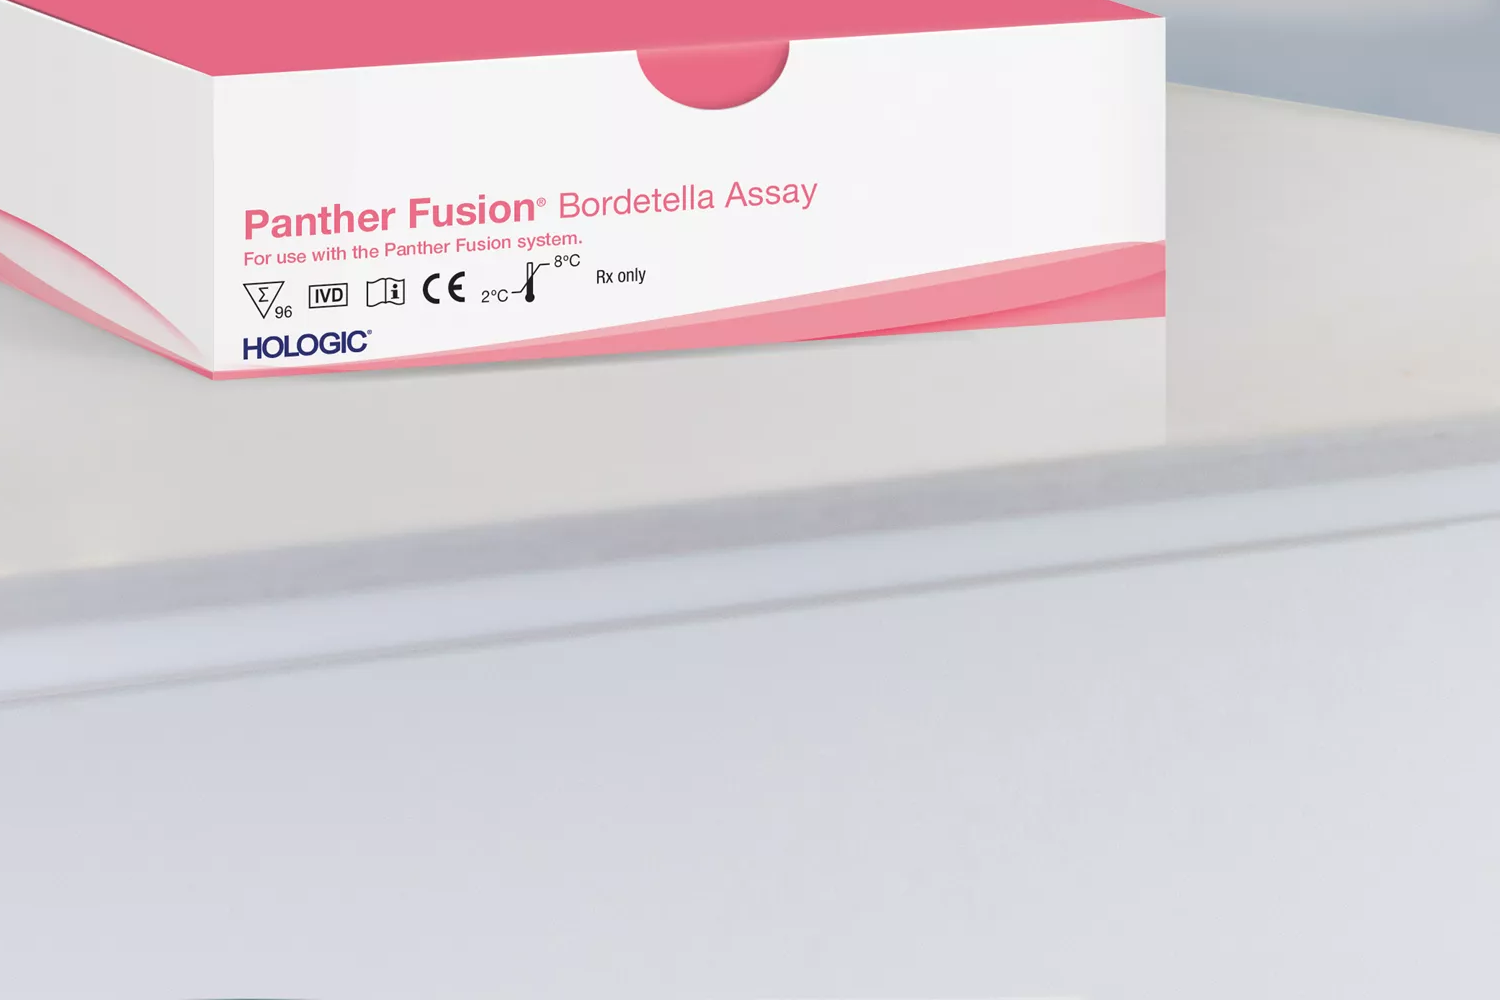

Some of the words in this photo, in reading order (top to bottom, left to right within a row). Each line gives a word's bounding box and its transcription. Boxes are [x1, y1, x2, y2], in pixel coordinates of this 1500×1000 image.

[244, 203, 397, 241] Panther
[559, 184, 716, 219] Bordetella
[724, 181, 818, 211] Assay
[243, 251, 273, 267] For
[276, 252, 307, 265] use
[311, 246, 347, 262] with
[351, 244, 380, 260] the
[384, 240, 451, 257] Panther
[455, 235, 512, 253] Fusion
[517, 232, 583, 252] system.
[553, 253, 582, 268] 8°C
[596, 269, 614, 285] Rx
[617, 267, 647, 285] only
[315, 287, 344, 304] IVD
[422, 270, 466, 305] CE
[481, 288, 510, 304] 2°C
[274, 305, 293, 319] 96
